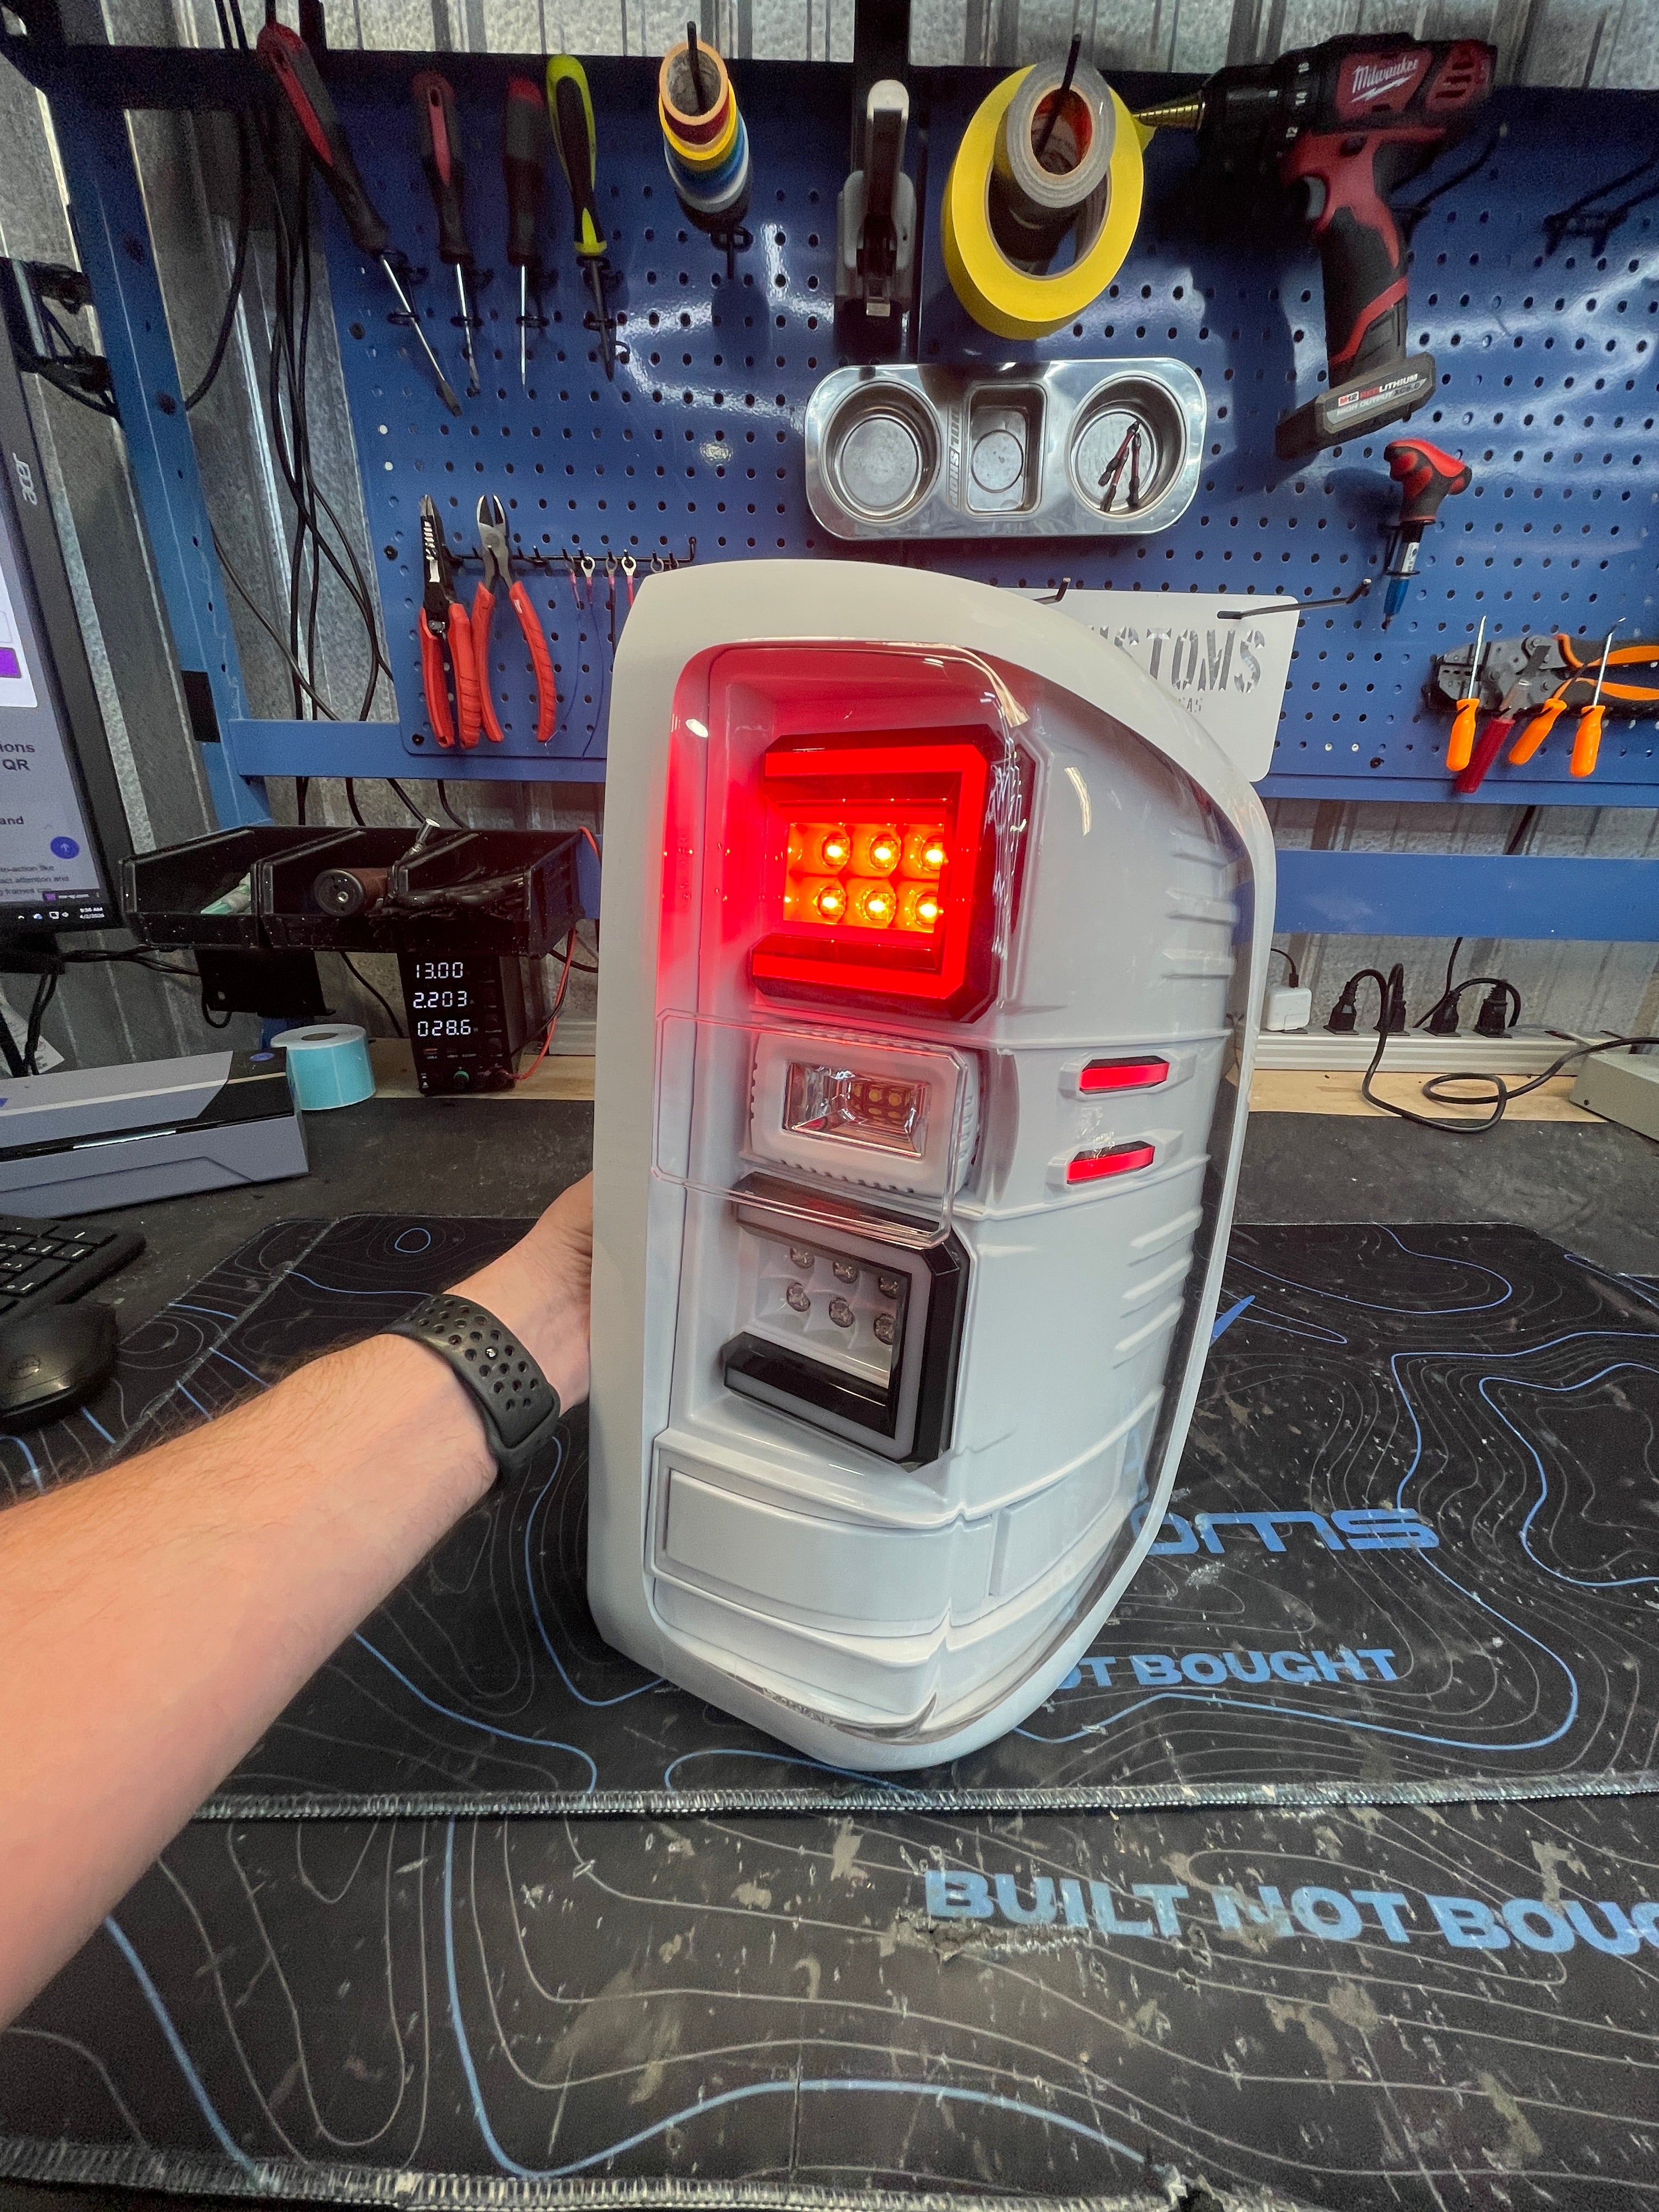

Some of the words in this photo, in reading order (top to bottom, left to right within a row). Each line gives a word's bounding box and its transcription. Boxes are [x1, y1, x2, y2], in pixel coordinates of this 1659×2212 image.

[1352, 55, 1419, 94] Milwaukee
[12, 452, 38, 505] acer
[2, 758, 31, 771] QR
[0, 816, 24, 825] and
[416, 962, 463, 979] 13.00
[413, 991, 467, 1008] 2.203
[417, 1019, 471, 1036] 028.6
[1128, 1648, 1401, 1686] BOUGHT
[925, 1870, 1189, 1938] BUILT
[1211, 1885, 1410, 1944] NOT
